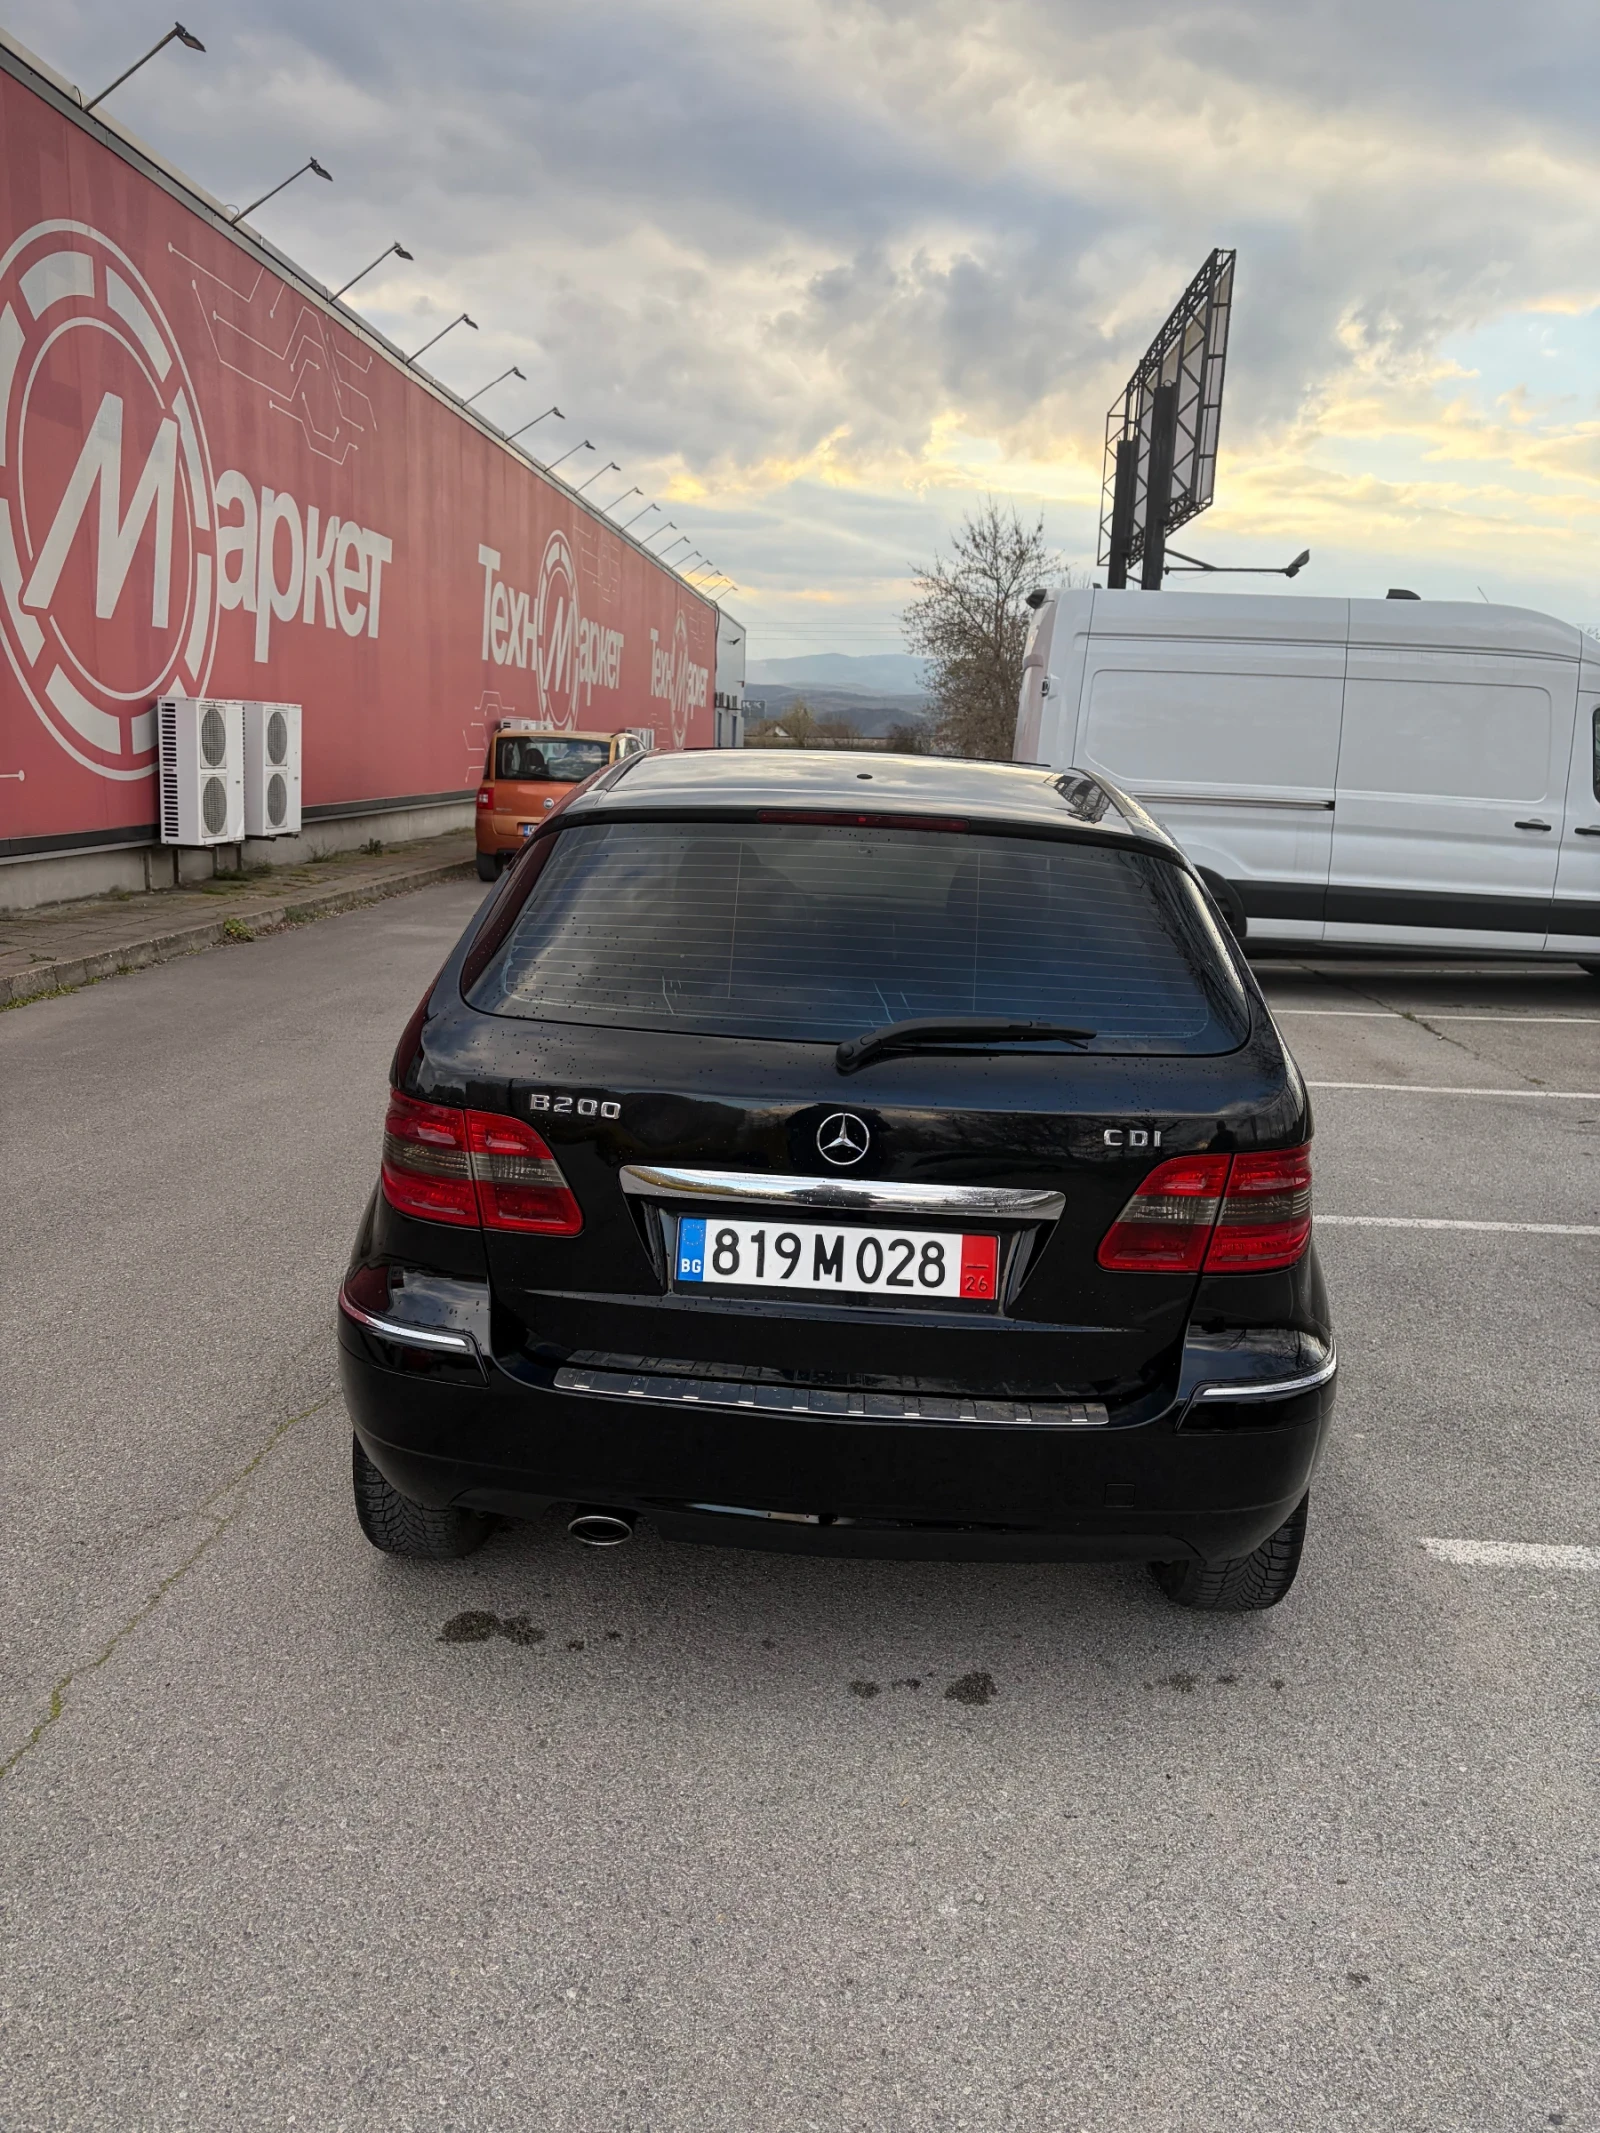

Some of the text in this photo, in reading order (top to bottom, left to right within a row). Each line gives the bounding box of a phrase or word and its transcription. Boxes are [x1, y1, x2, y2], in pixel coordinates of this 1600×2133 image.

[530, 1093, 621, 1119] B200
[1103, 1129, 1162, 1147] CDI
[681, 1258, 702, 1273] BG
[965, 1275, 988, 1292] 26
